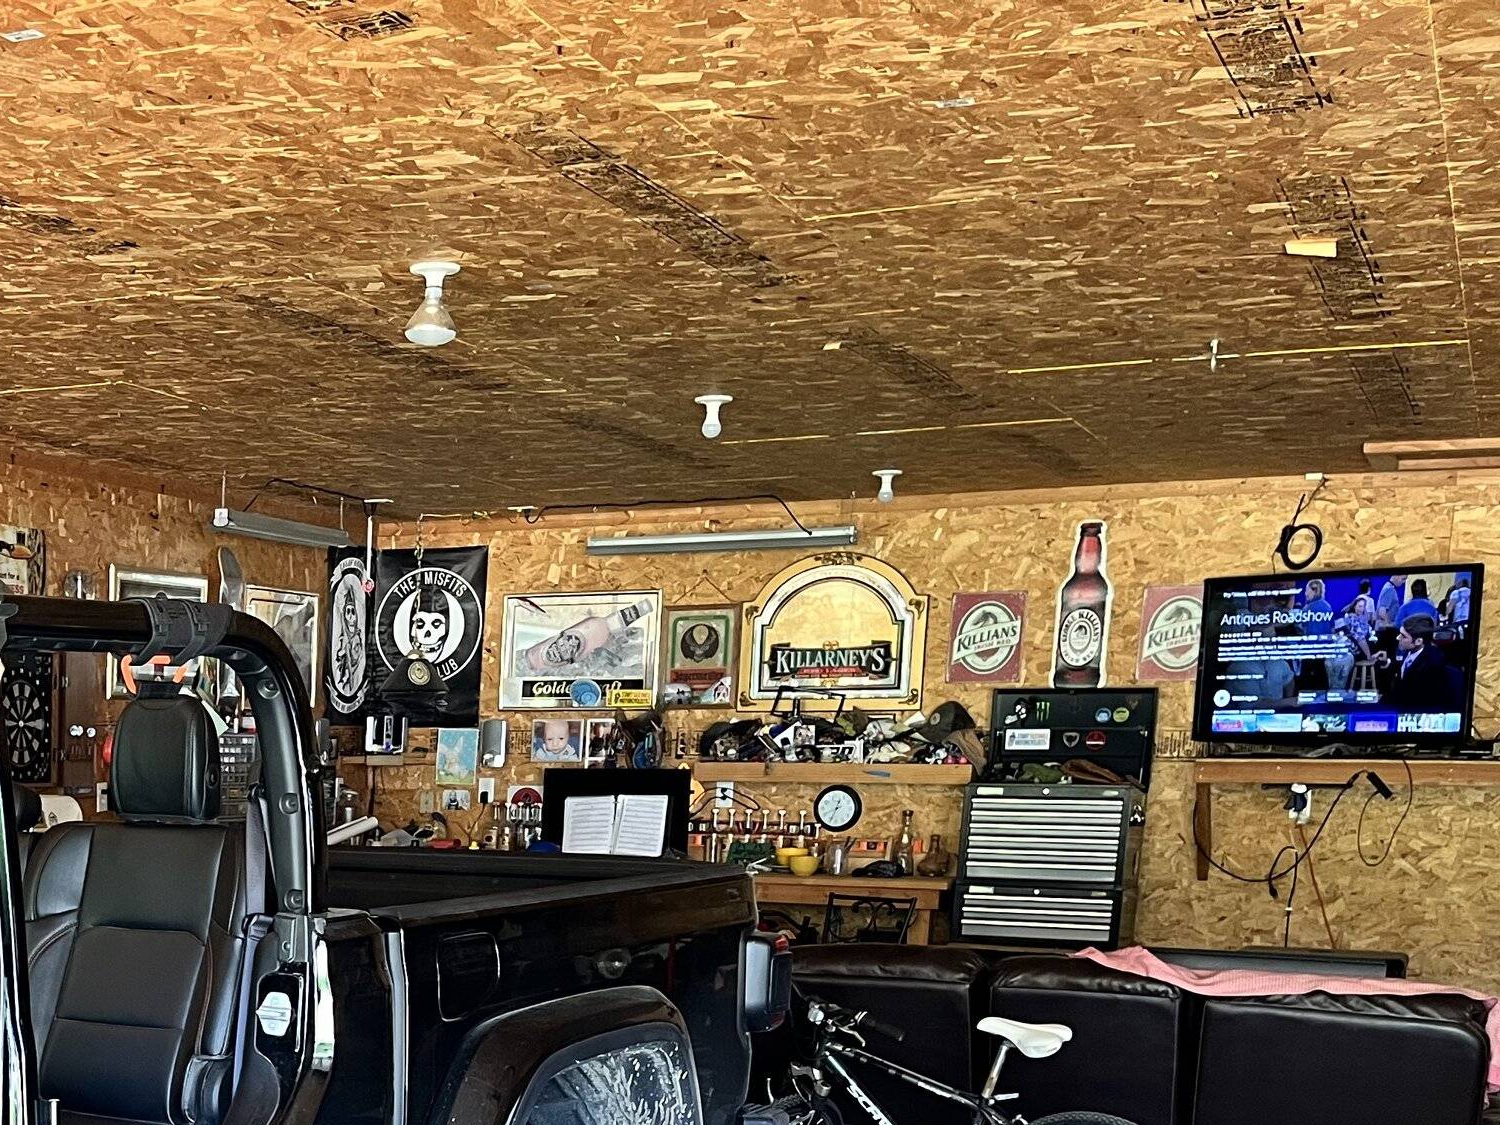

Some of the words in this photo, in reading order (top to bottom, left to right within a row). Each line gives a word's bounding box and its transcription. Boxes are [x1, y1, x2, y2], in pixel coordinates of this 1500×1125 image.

[394, 577, 416, 599] THE
[424, 572, 468, 597] MISFITS
[1220, 613, 1270, 627] Antiques
[1272, 610, 1334, 624] Roadshow
[436, 659, 459, 678] LUB
[776, 648, 885, 673] KILLARNEY'S
[532, 680, 571, 695] Golde
